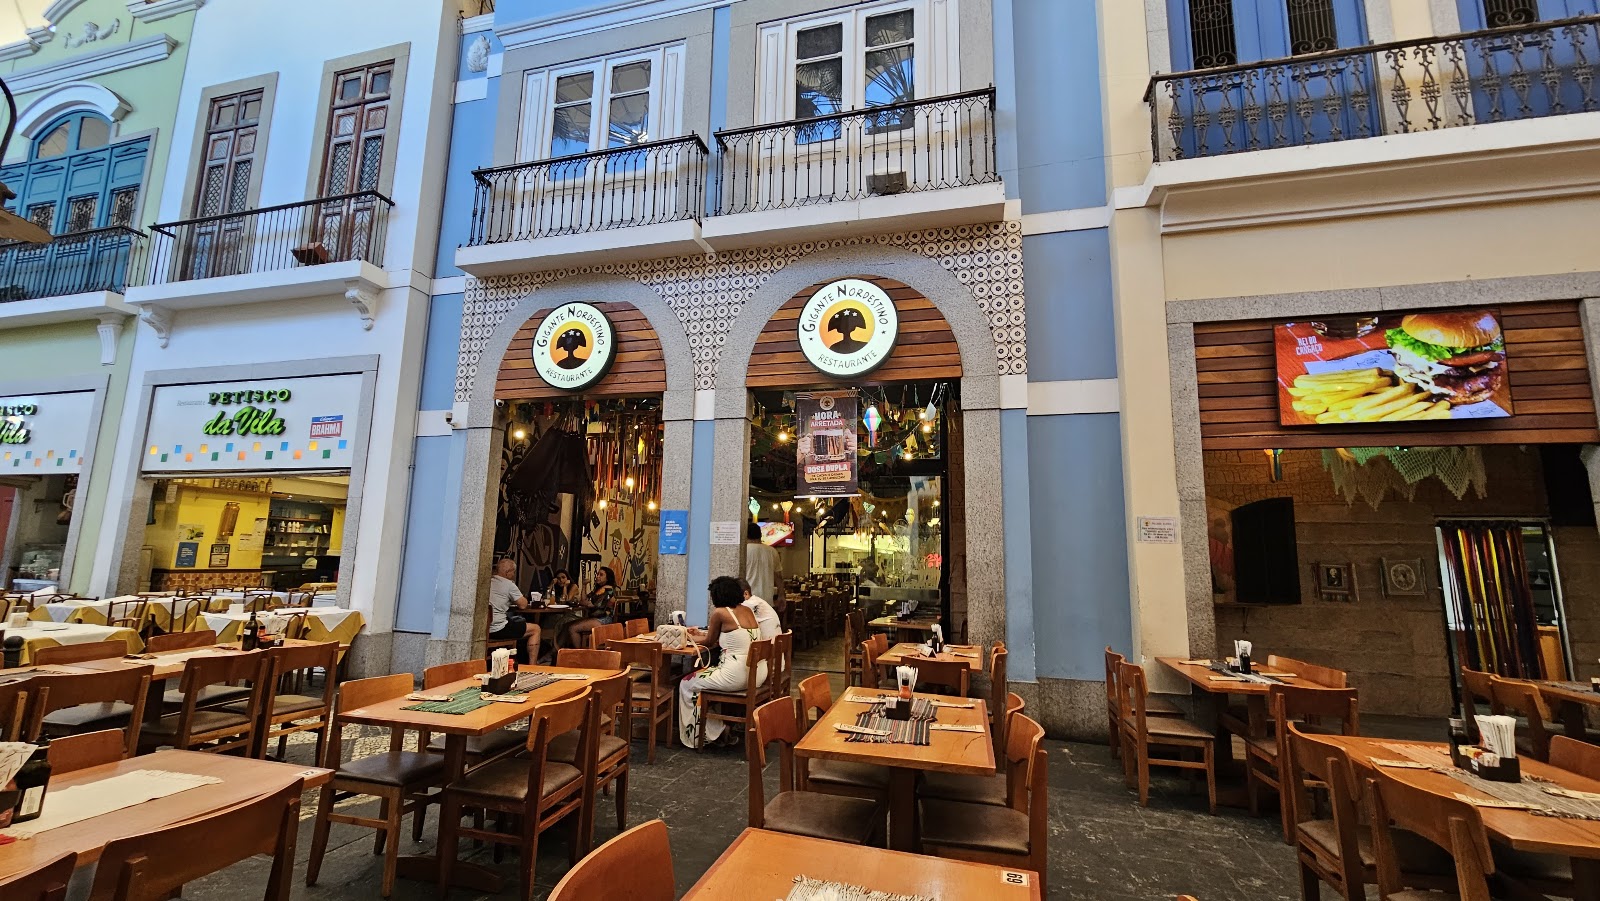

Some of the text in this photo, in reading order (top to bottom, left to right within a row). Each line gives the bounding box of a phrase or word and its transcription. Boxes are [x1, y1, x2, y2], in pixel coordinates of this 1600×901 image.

[801, 284, 889, 332] GIGANTE NORDESTINO
[536, 305, 605, 347] GIGANTE NORDESTINO
[1295, 343, 1323, 356] CANGAÇO
[817, 349, 878, 369] RESTAURANTE
[545, 366, 593, 382] RESTAURANTE
[207, 388, 292, 405] PETISCO
[202, 405, 286, 436] da Vila
[810, 419, 843, 427] ARRETADA
[814, 410, 839, 420] HORA
[311, 422, 341, 436] BRAHMA
[807, 463, 848, 473] DOSE DUPLA
